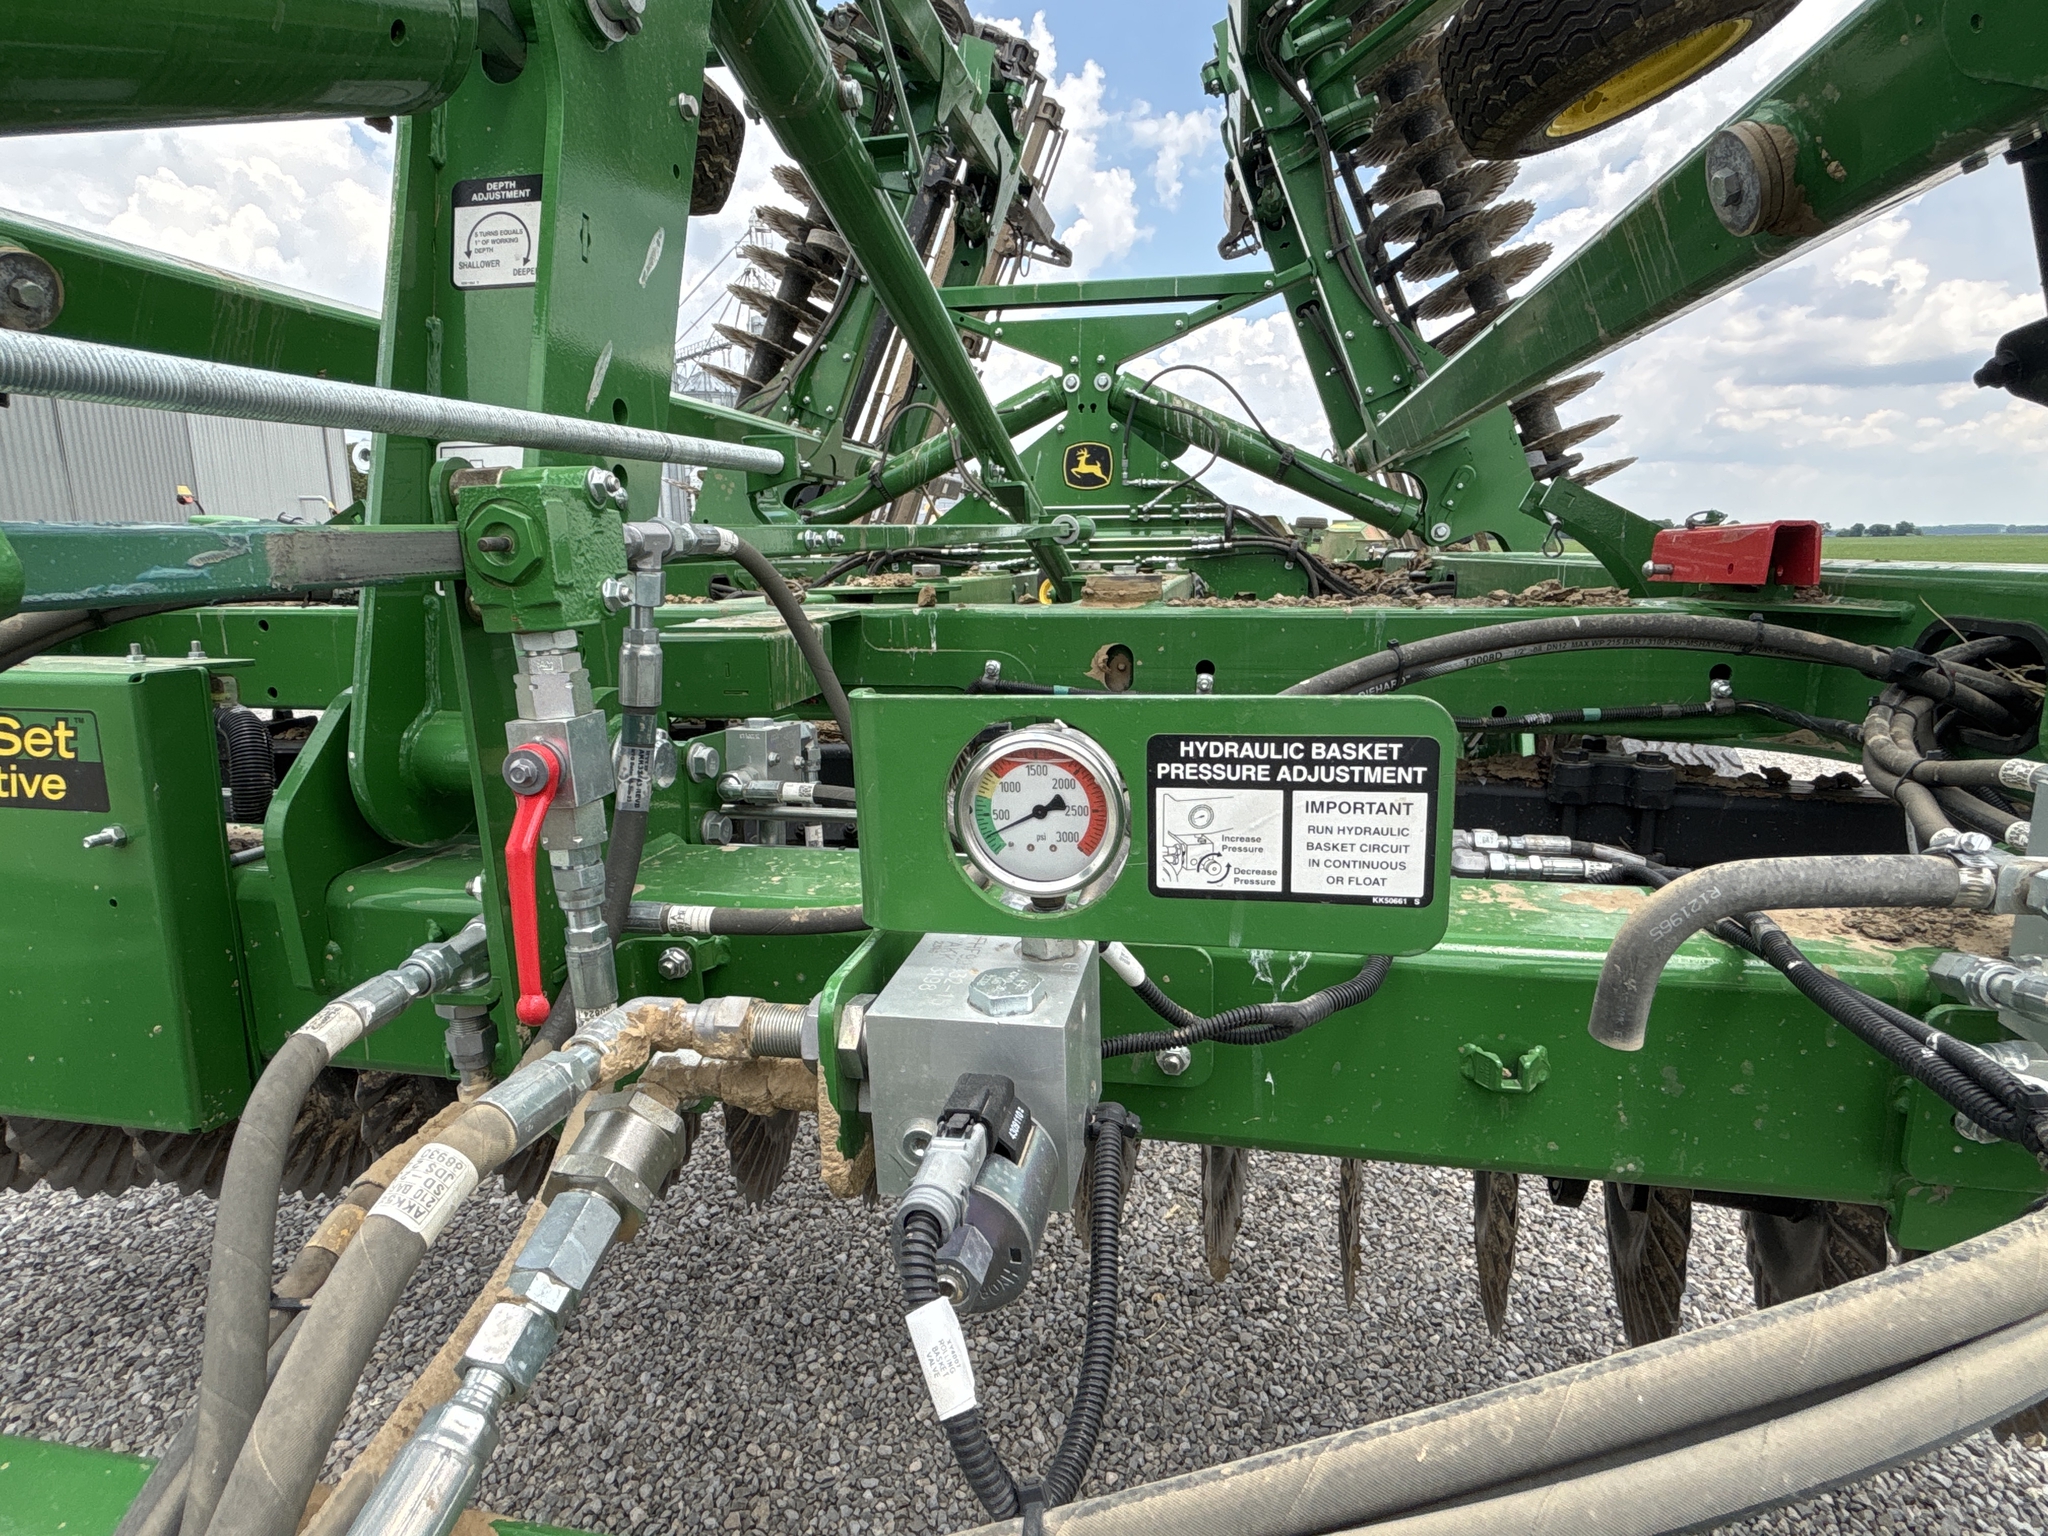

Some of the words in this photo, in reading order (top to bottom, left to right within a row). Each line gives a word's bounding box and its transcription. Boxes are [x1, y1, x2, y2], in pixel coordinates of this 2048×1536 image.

[486, 181, 516, 191] DEPTH
[471, 189, 531, 201] ADJUSTMENT
[491, 237, 518, 245] WORKING
[458, 260, 500, 270] SHALLOWER
[512, 267, 537, 276] DEEPE
[1464, 652, 1503, 667] T3008D
[1546, 642, 1567, 651] DN12
[1571, 640, 1589, 648] MAX
[1591, 639, 1605, 647] WP
[1606, 638, 1621, 646] 215
[1622, 638, 1640, 646] BAR
[1180, 741, 1305, 760] HYDRAULIC
[1311, 742, 1403, 761] BASKET
[1025, 764, 1048, 776] 1500
[1157, 763, 1270, 782] PRESSURE
[1276, 766, 1428, 785] ADJUSTMENT
[1000, 781, 1021, 793] 1000
[1052, 778, 1076, 790] 2000
[1065, 805, 1089, 817] 2500
[1305, 800, 1414, 816] IMPORTANT
[993, 809, 1010, 820] 500
[1036, 832, 1047, 841] psi
[1056, 831, 1080, 843] 3000
[1307, 825, 1334, 835] RUN
[1337, 826, 1410, 837] HYDRAULIC
[1221, 834, 1262, 843] Increase
[1221, 845, 1264, 854] Pressure
[1306, 842, 1356, 853] BASKET
[1359, 843, 1410, 854] CIRCUIT
[1308, 858, 1320, 868] IN
[1323, 859, 1407, 871] CONTINUOUS
[1234, 867, 1278, 877] Decrease
[1233, 877, 1276, 886] Pressure
[1326, 875, 1345, 886] OR
[1348, 876, 1388, 887] FLOAT
[1649, 886, 1722, 942] R121965
[426, 1162, 455, 1182] JDS
[423, 1177, 445, 1196] SD
[413, 1188, 436, 1208] 210
[931, 1345, 950, 1378] BASKET
[938, 1338, 956, 1375] ROLLING
[926, 1351, 940, 1379] VALVE
